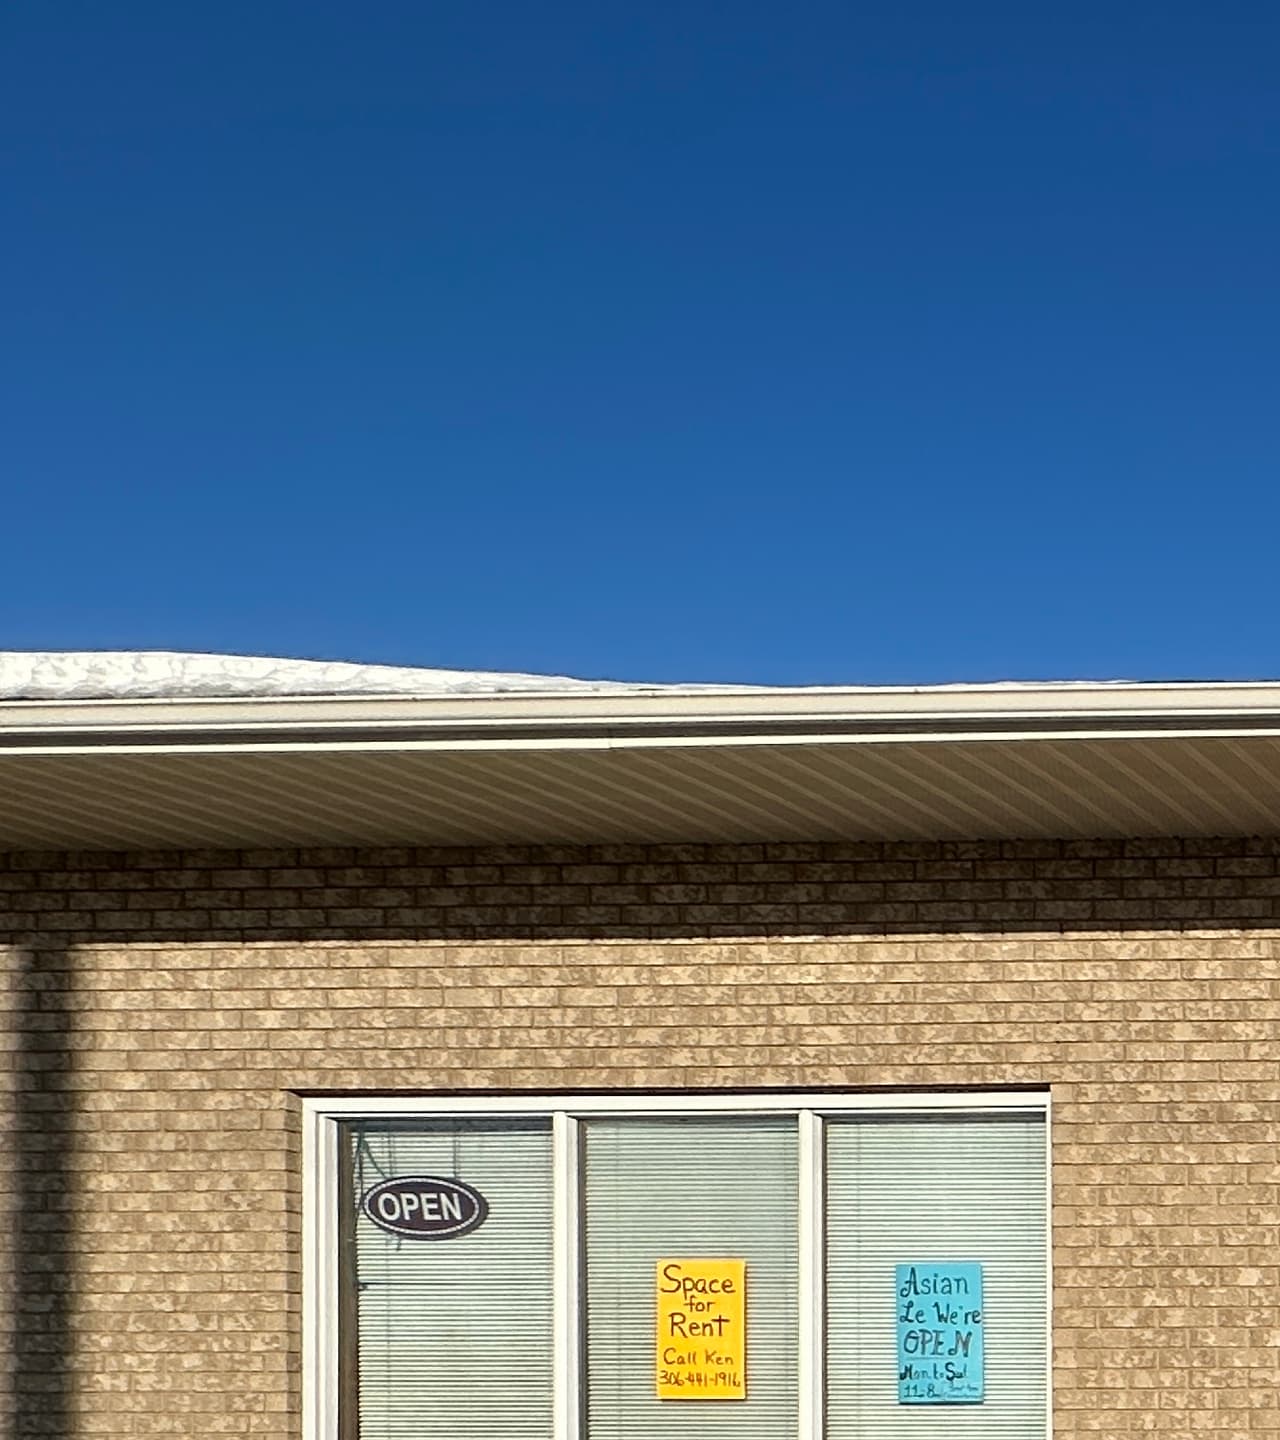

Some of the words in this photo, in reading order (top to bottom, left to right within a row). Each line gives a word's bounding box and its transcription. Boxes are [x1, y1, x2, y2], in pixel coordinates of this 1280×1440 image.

[377, 1192, 463, 1221] OPEN
[661, 1264, 736, 1300] Space
[900, 1267, 969, 1297] Asian
[683, 1294, 716, 1312] for
[900, 1300, 926, 1323] Le
[932, 1301, 981, 1324] We're
[668, 1312, 731, 1338] Rent
[663, 1347, 697, 1365] Call
[705, 1349, 734, 1365] Ken
[903, 1329, 972, 1357] OPEN
